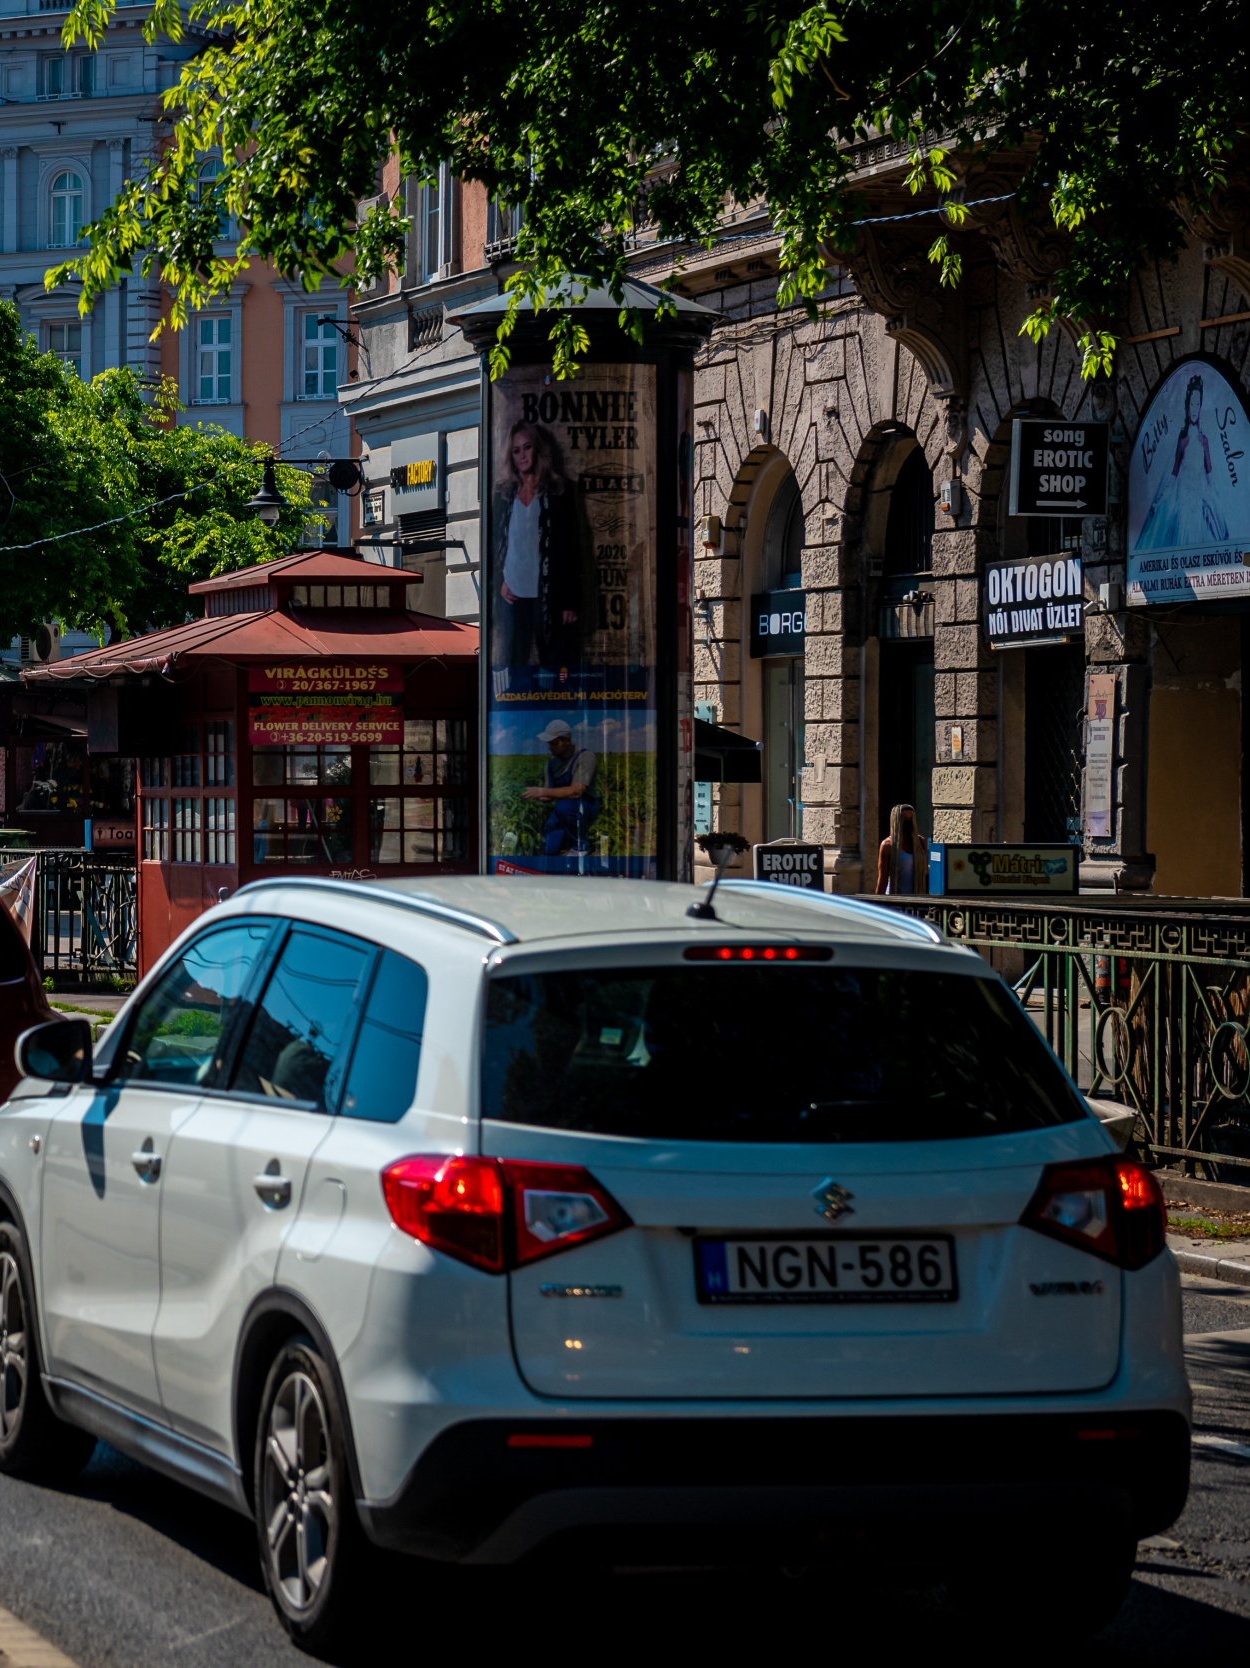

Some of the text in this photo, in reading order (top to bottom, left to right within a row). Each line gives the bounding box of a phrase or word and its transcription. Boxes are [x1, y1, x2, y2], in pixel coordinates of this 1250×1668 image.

[521, 391, 638, 423] BONNIE
[567, 426, 639, 450] TYLER
[1043, 429, 1085, 447] song
[1141, 413, 1169, 475] Betty
[1215, 407, 1245, 488] Szalon
[1033, 449, 1094, 469] EROTIC
[583, 478, 641, 491] TRACK
[1038, 474, 1087, 493] SHOP
[1139, 558, 1169, 573] AMERIKAI
[1170, 554, 1179, 570] ÉS
[1180, 554, 1200, 569] OLASZ
[1234, 549, 1243, 564] ÉS
[596, 568, 628, 587] JUN
[988, 558, 1082, 605] OKTOGON
[1131, 578, 1159, 593] ALKALMI
[1160, 574, 1182, 591] RUHÁK
[1184, 575, 1205, 588] EXTRA
[1207, 571, 1245, 587] MÉRETBEN
[598, 594, 627, 630] 19
[988, 601, 1082, 635] NŐI DIVAT ÜZLET
[759, 611, 806, 635] BORG
[264, 665, 389, 679] VIRÁGKÜLDÉS
[292, 680, 376, 691] 20/367-1967
[260, 693, 392, 708] www.pannonvirag.hu
[495, 689, 648, 702] GAZDASÁGVÉDELMI AKCIÓTERV
[253, 722, 400, 731] FLOWER DELIVERY SERVICE
[281, 732, 382, 742] +36-20-519-5699
[762, 853, 818, 871] EROTIC
[769, 872, 812, 887] SHOP
[707, 1245, 941, 1288] H NGN-586
